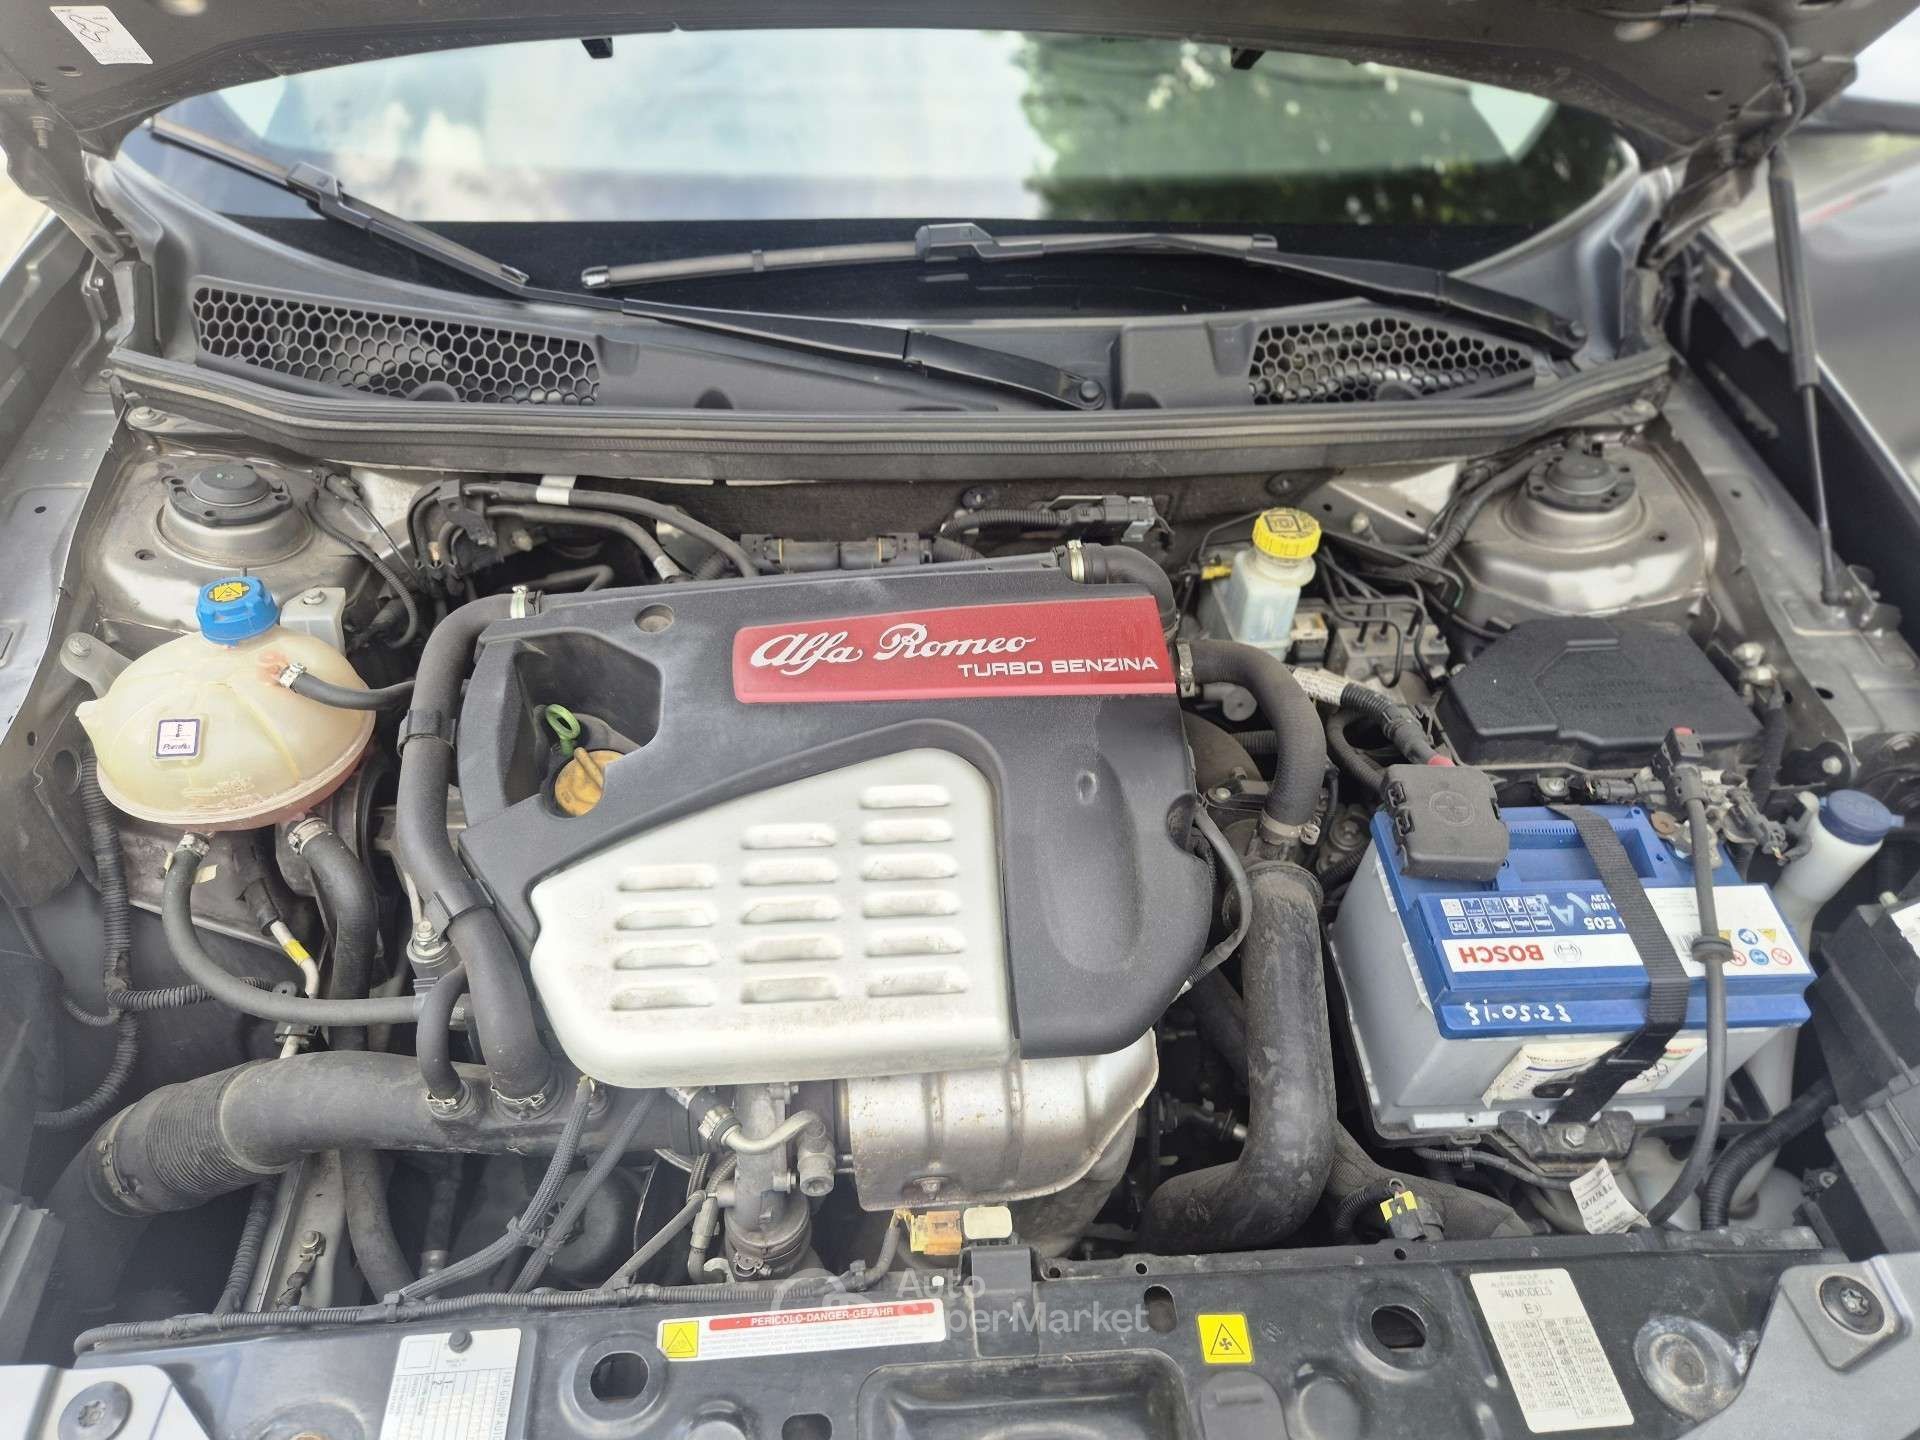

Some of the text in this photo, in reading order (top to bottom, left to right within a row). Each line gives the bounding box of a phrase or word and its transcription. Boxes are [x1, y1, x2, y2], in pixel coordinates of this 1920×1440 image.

[750, 622, 1037, 676] Alfa Romeo
[958, 656, 1158, 679] TURBO BENZINA
[1583, 916, 1617, 930] E05
[1458, 944, 1544, 963] BOSCH
[751, 1306, 894, 1327] PERICOLO-DANGER-GEFAHR
